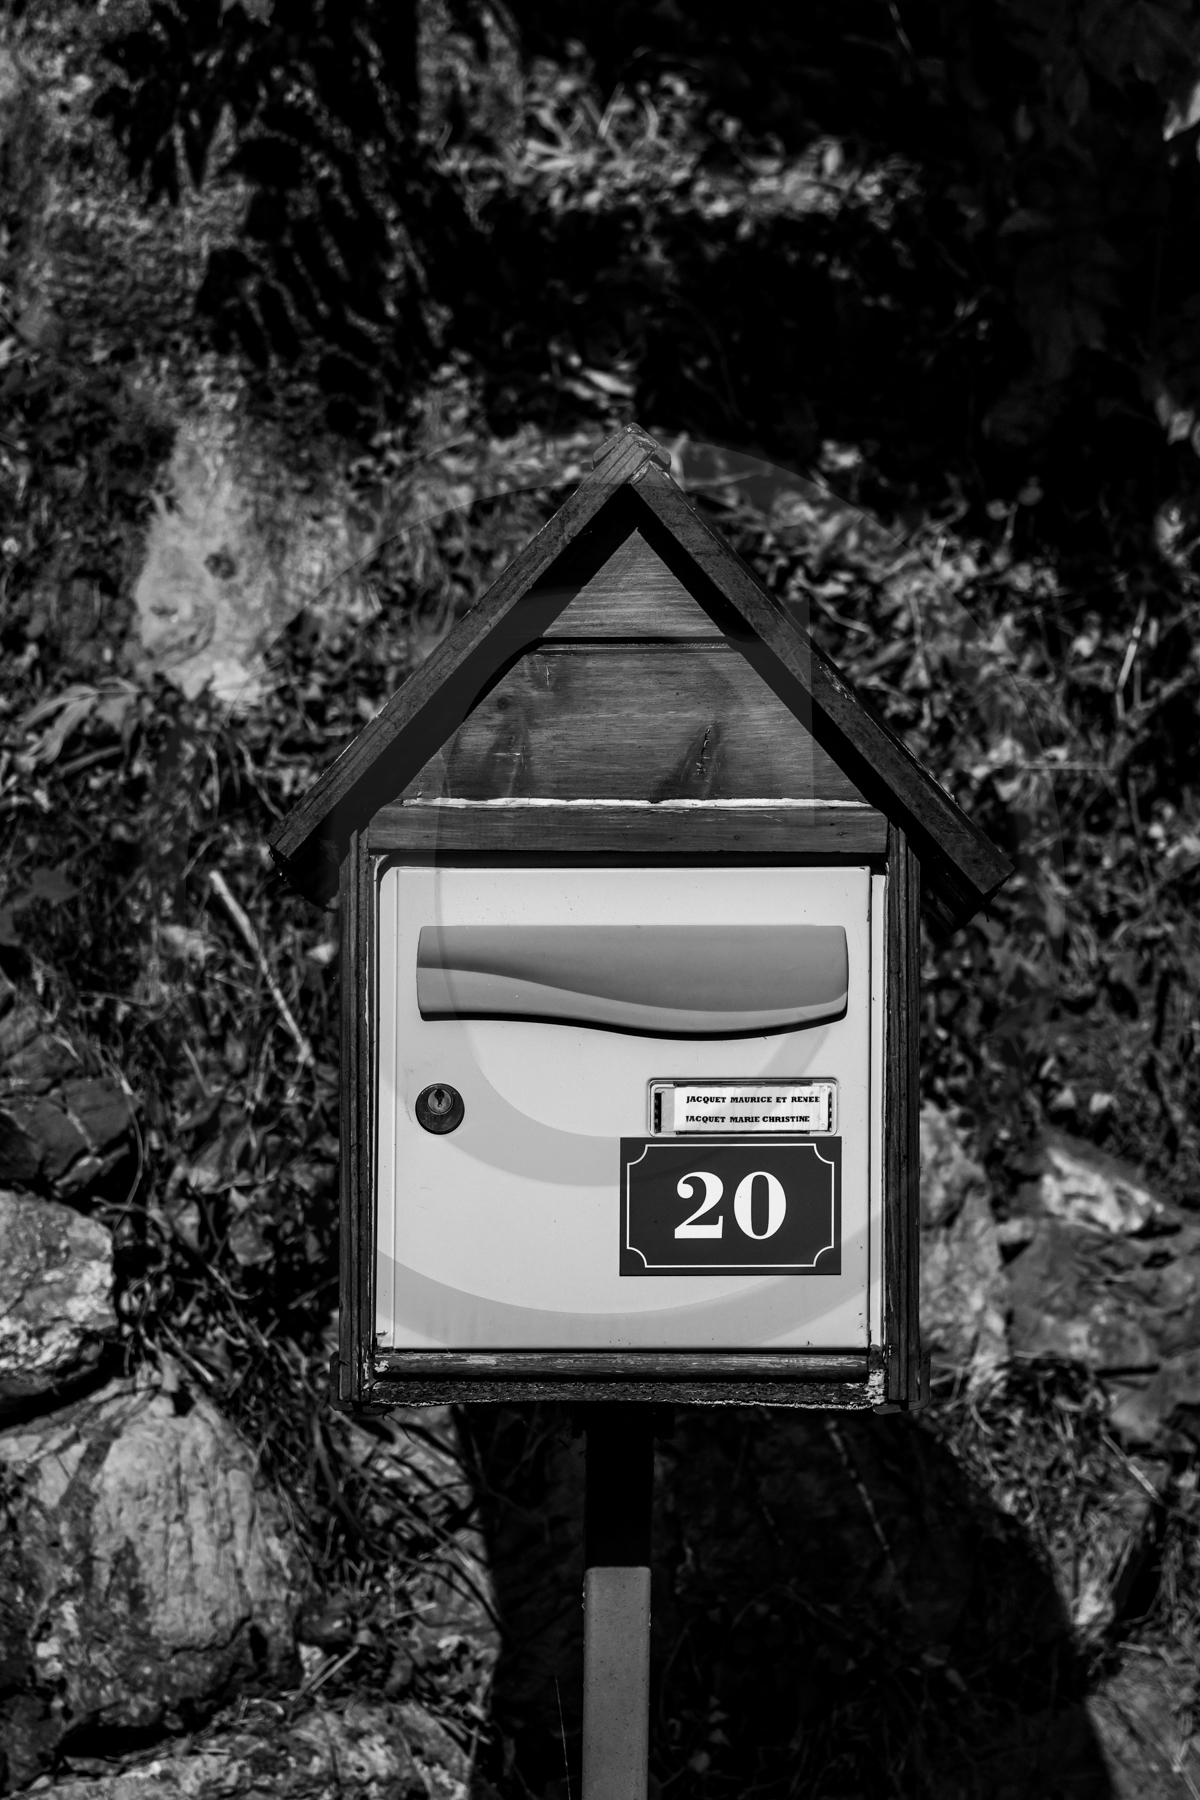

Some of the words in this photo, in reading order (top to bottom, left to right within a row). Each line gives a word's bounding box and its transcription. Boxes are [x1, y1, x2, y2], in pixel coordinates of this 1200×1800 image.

[686, 1096, 727, 1105] JACQUET
[730, 1096, 773, 1104] MAURICE
[775, 1096, 788, 1104] ET
[685, 1115, 726, 1124] JACQUET
[674, 1171, 787, 1240] 20
